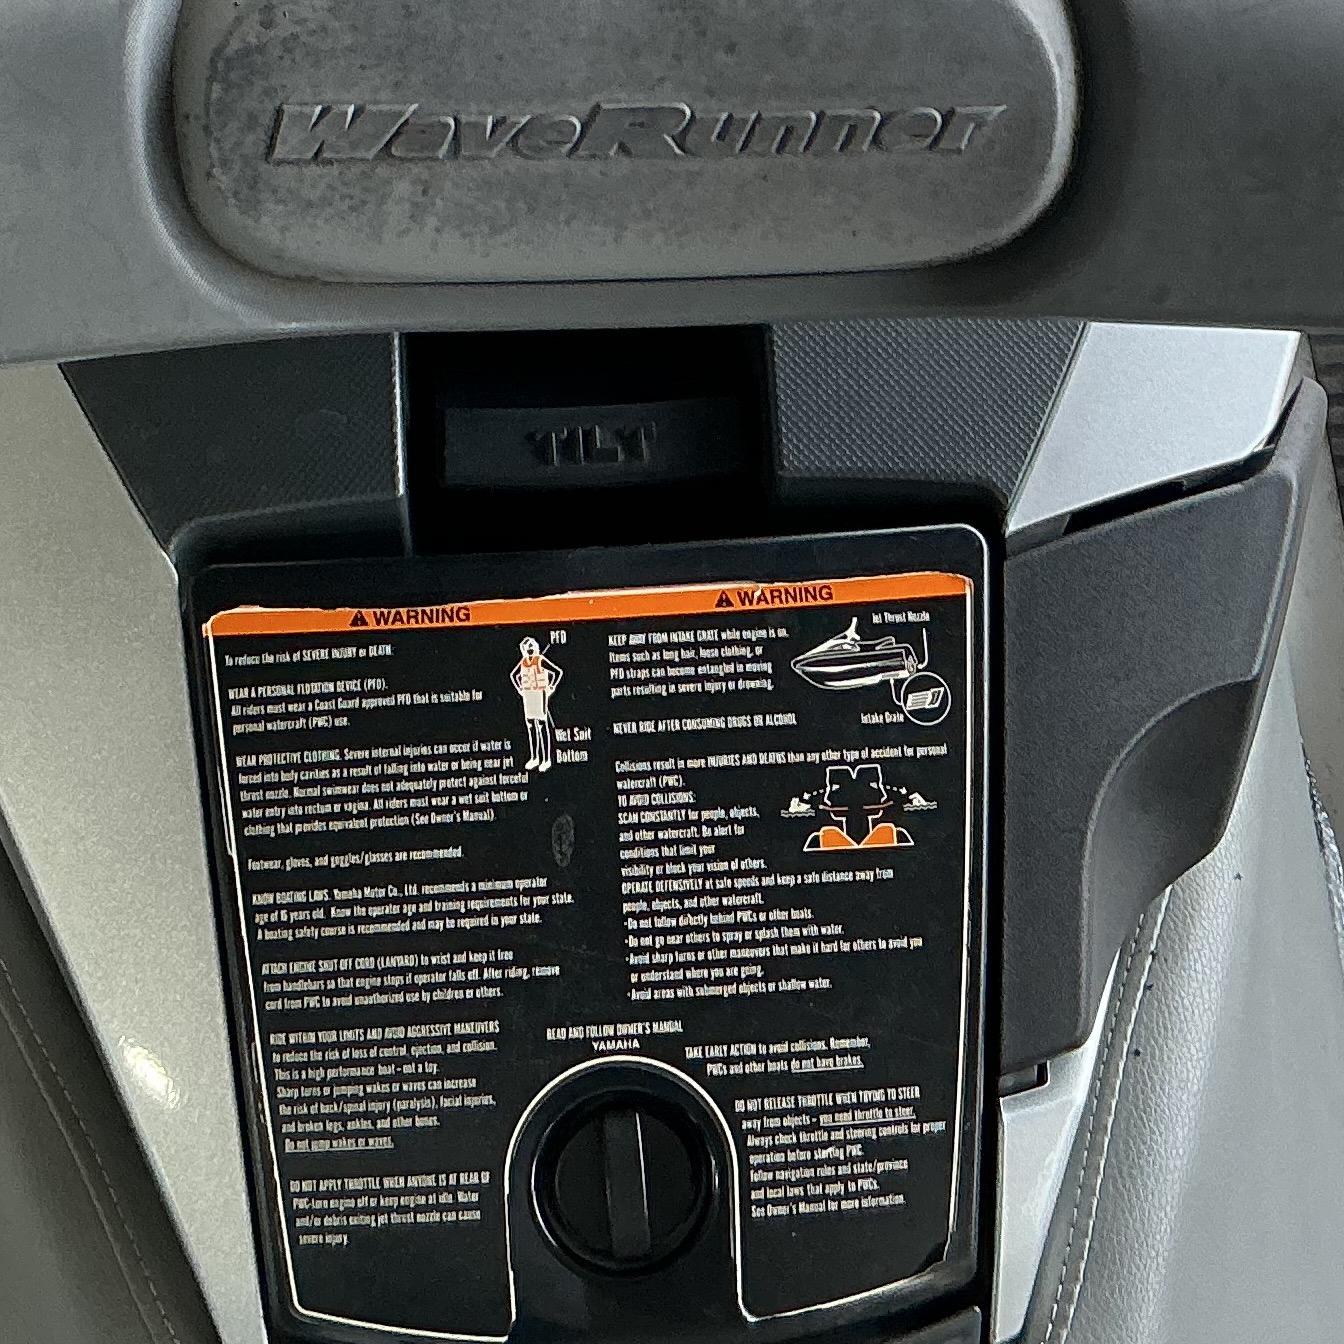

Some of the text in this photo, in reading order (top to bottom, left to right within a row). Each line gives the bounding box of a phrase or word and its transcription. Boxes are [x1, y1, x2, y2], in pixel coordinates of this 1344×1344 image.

[267, 102, 1007, 164] WaveRunner
[737, 584, 834, 609] WARNING
[373, 605, 472, 628] WARNING
[549, 629, 567, 644] PFD
[554, 726, 592, 742] Wet Suit
[555, 748, 588, 763] Bottom
[591, 1038, 640, 1051] YAMAHA
